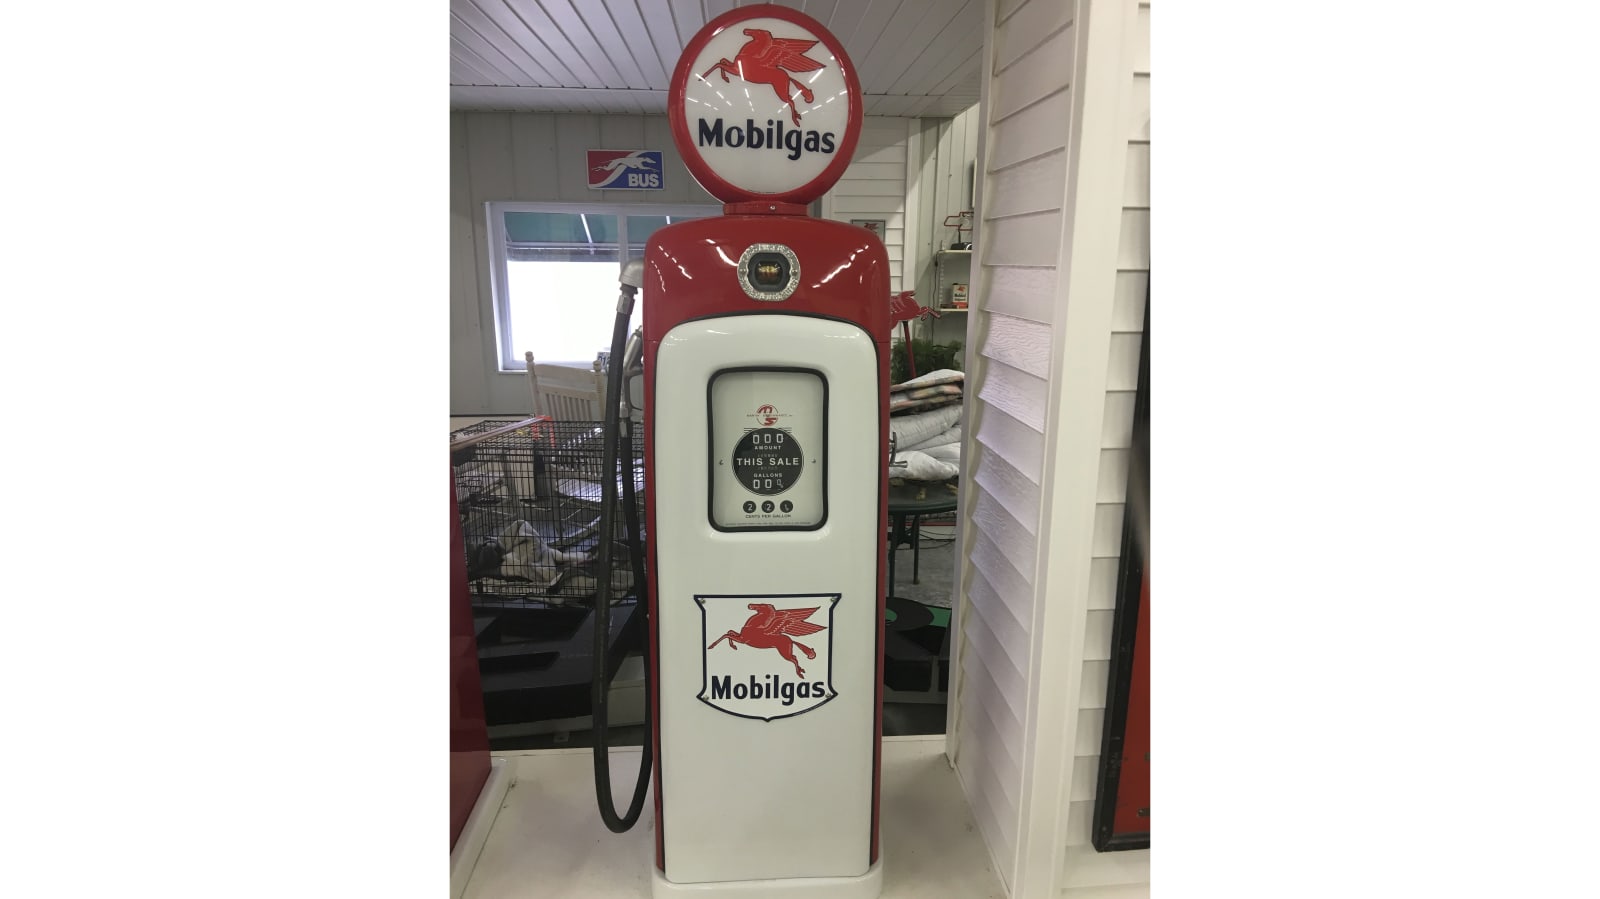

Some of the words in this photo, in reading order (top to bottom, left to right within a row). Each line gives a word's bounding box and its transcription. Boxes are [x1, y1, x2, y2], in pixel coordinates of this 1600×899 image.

[698, 118, 835, 161] Mobilgas
[628, 173, 659, 188] BUS
[736, 457, 763, 466] THIS
[769, 457, 800, 466] SALE
[711, 674, 826, 706] Mobilgas
